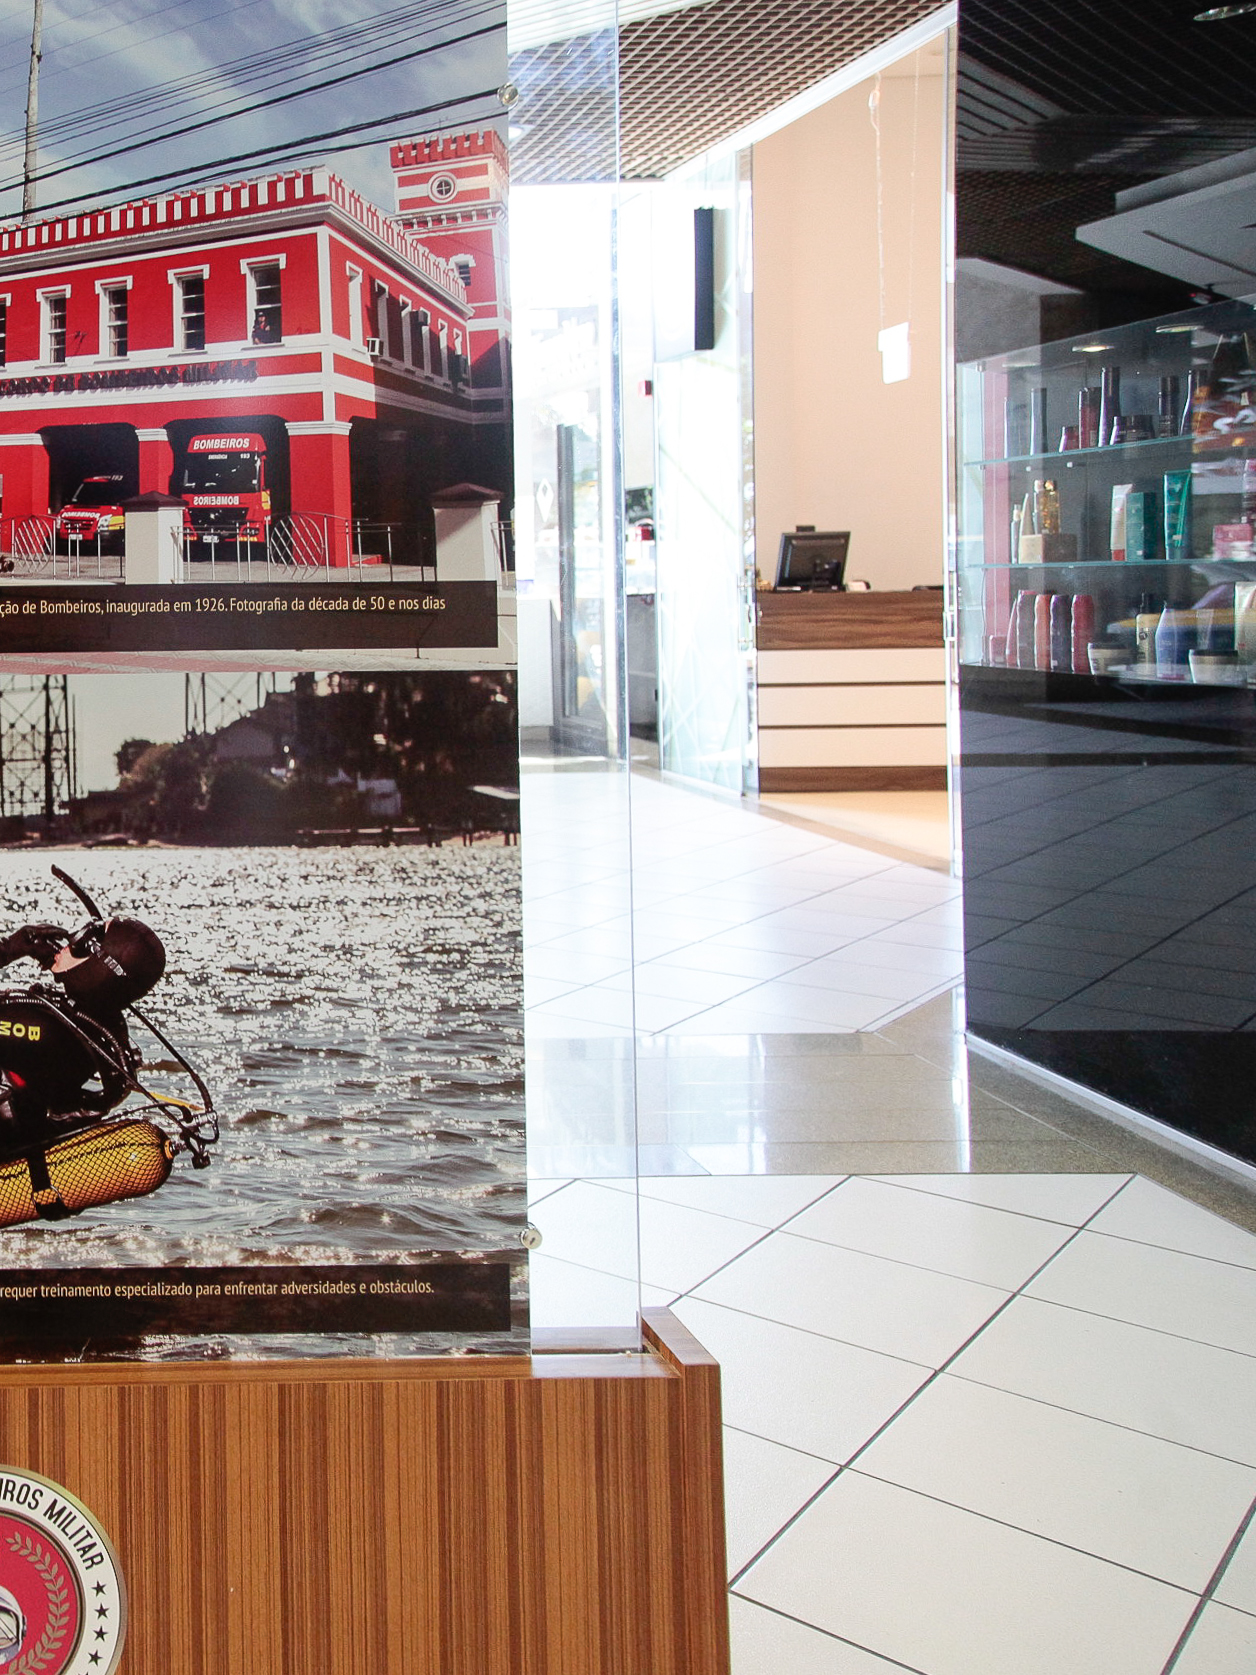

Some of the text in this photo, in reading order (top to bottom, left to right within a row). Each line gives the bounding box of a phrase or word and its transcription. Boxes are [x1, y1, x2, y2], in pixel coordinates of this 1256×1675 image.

[193, 438, 250, 450] BOMBEIROS
[22, 601, 37, 614] de
[40, 600, 104, 615] Bombeiros,
[106, 599, 171, 616] inaugurada
[173, 601, 192, 612] em
[195, 598, 228, 612] 1926.
[230, 597, 288, 615] Fotografia
[291, 597, 305, 611] da
[308, 596, 349, 611] década
[352, 596, 367, 611] de
[370, 596, 385, 610] 50
[388, 600, 396, 610] e
[398, 599, 419, 610] nos
[422, 596, 446, 610] dias
[0, 1286, 37, 1300] requer
[40, 1283, 112, 1297] treinamento
[114, 1281, 192, 1298] especializado
[195, 1284, 221, 1298] para
[224, 1281, 278, 1295] enfrentar
[281, 1280, 356, 1295] adversidades
[359, 1283, 367, 1294] e
[369, 1279, 435, 1294] obstáculos.
[43, 1499, 105, 1571] MILITAR
